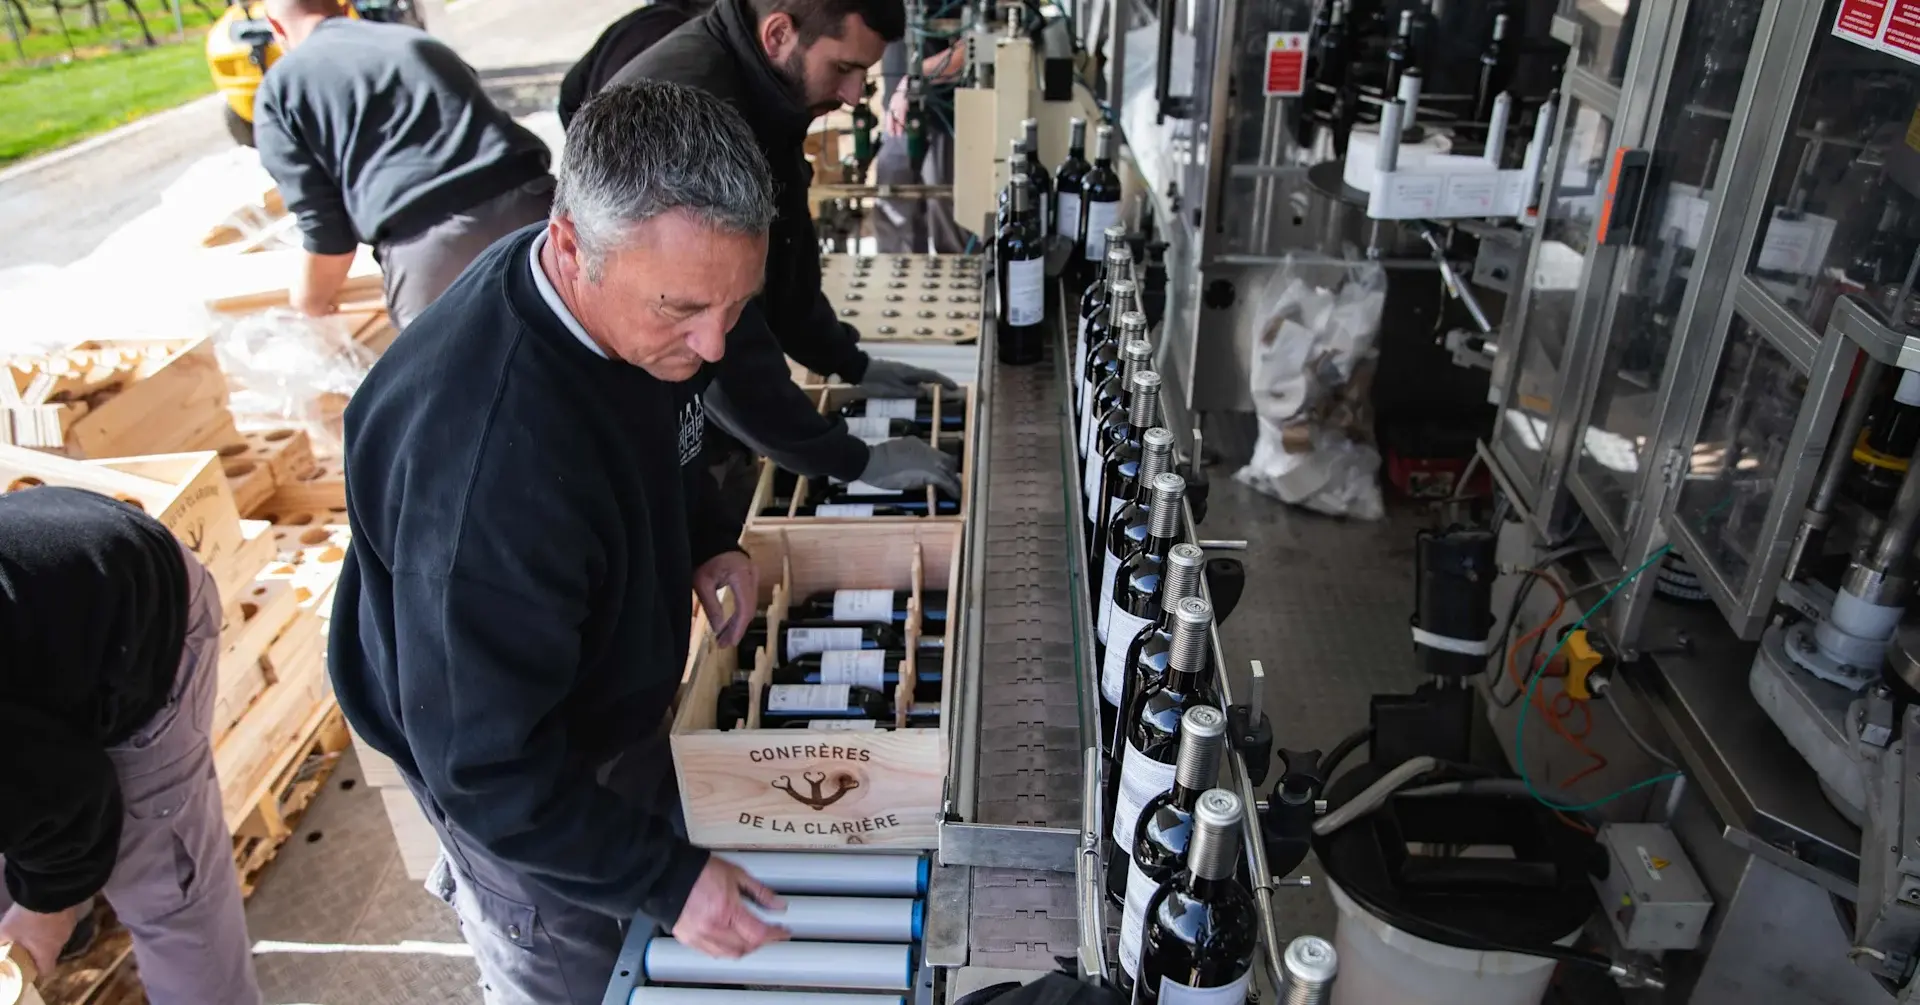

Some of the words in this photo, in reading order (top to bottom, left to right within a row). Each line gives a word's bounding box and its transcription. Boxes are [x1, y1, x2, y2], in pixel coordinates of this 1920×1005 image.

[750, 743, 870, 762] CONFRÈRES
[739, 812, 764, 829] DE
[771, 819, 795, 833] LA
[804, 814, 900, 835] CLARIÈRE
